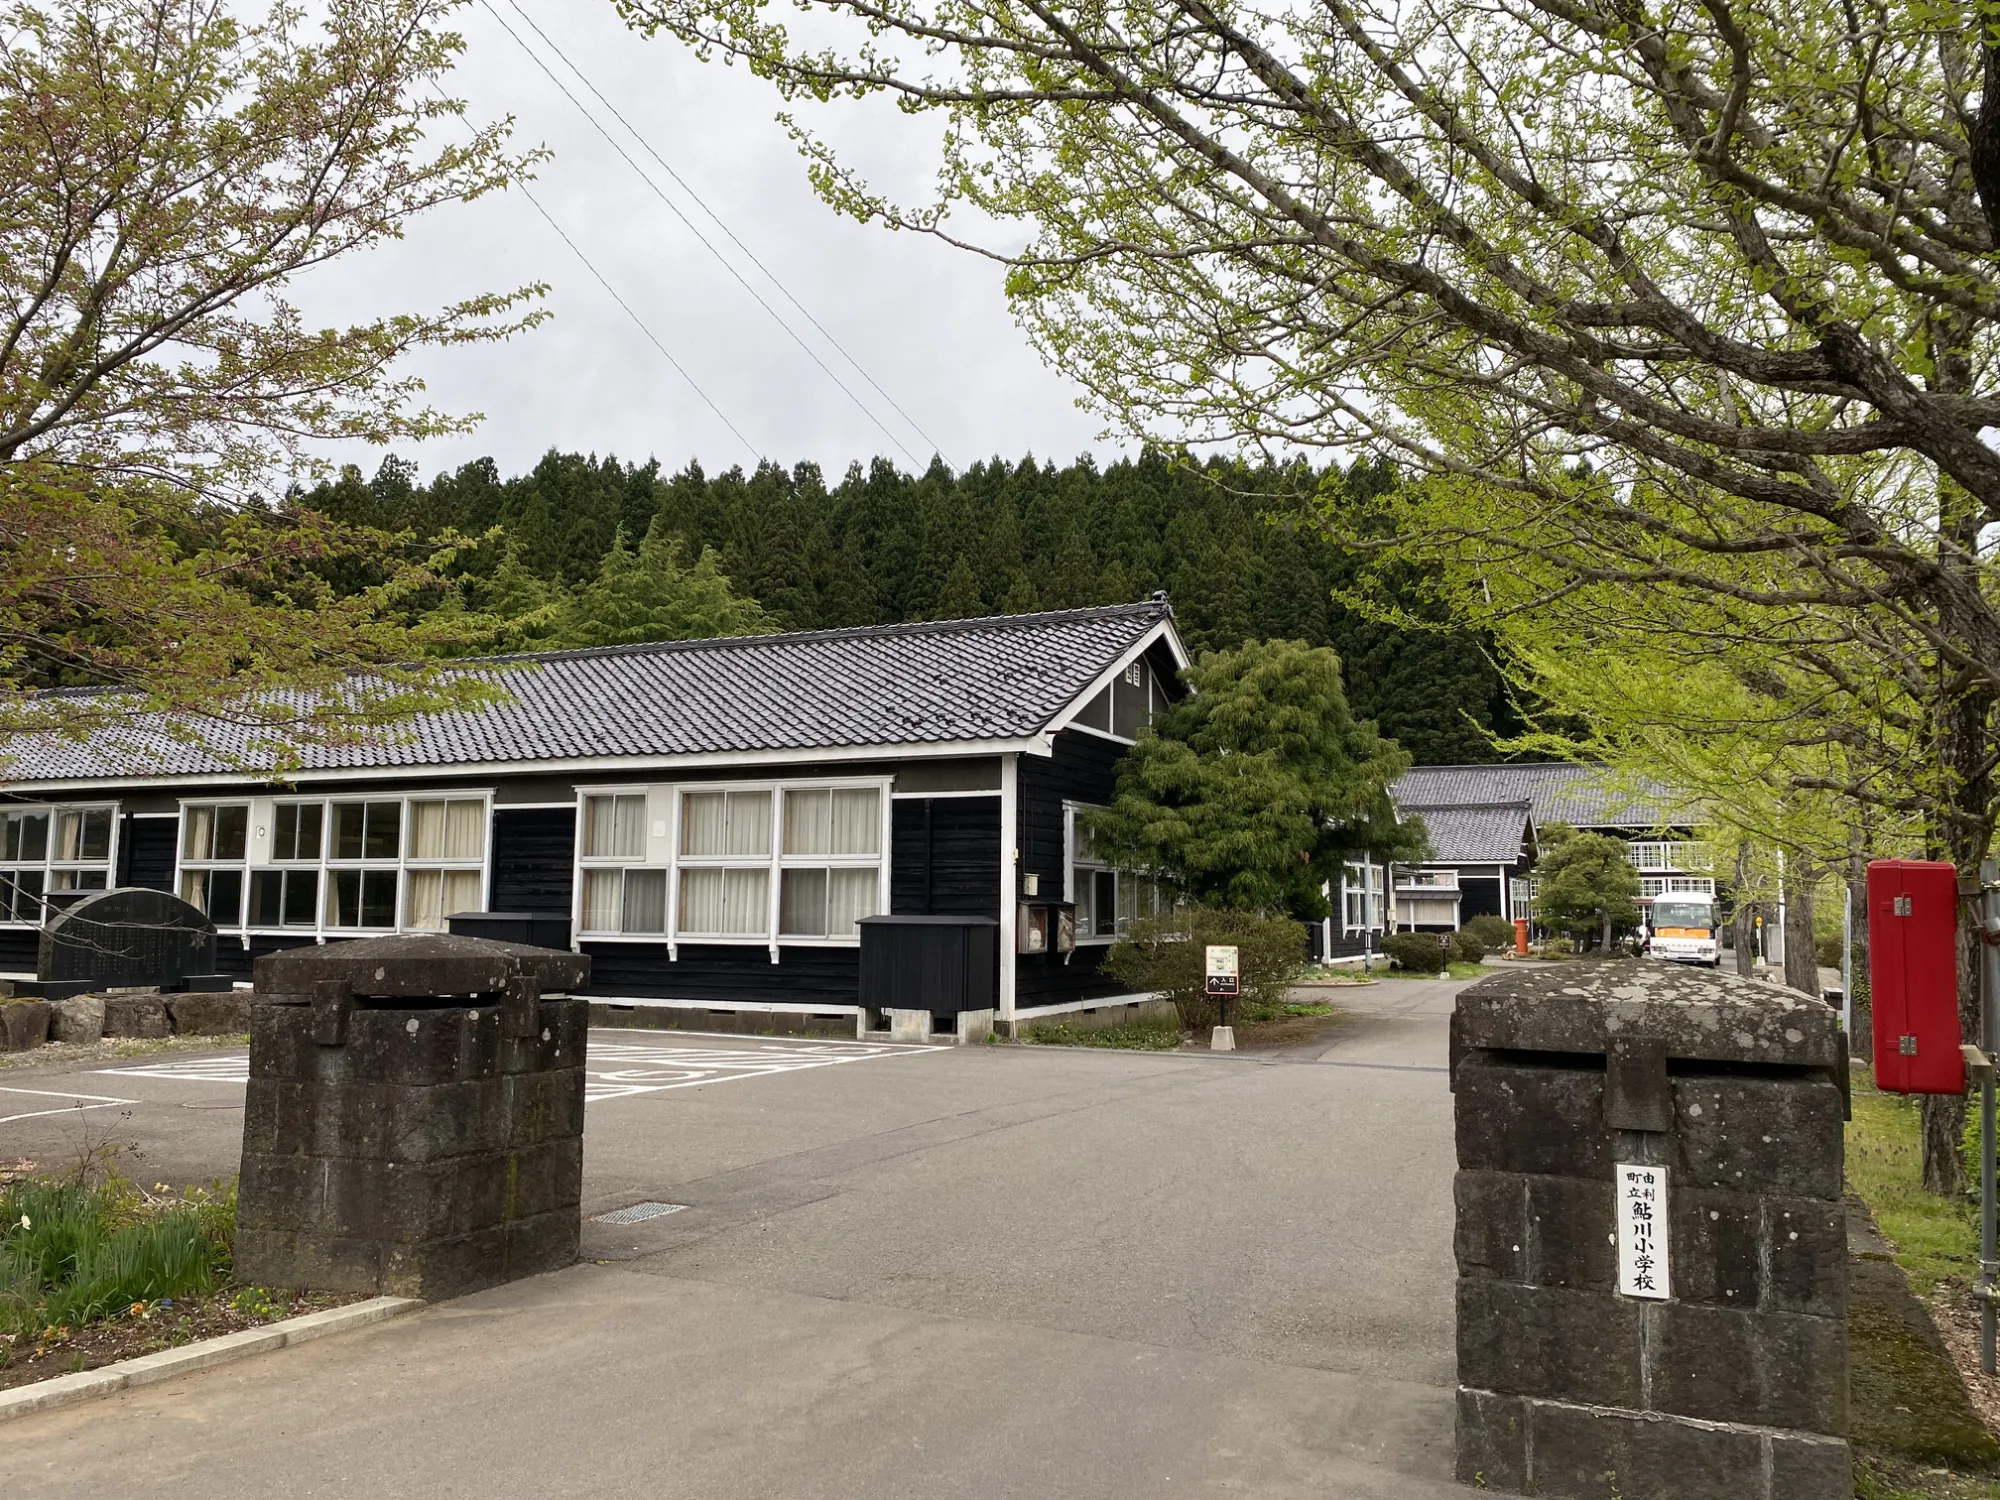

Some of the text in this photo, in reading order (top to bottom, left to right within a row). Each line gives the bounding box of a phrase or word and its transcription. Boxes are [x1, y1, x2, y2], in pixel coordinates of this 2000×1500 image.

[1626, 1172, 1642, 1199] 町立
[1642, 1172, 1655, 1202] 由利
[1632, 1201, 1656, 1291] 鮎川小学校
